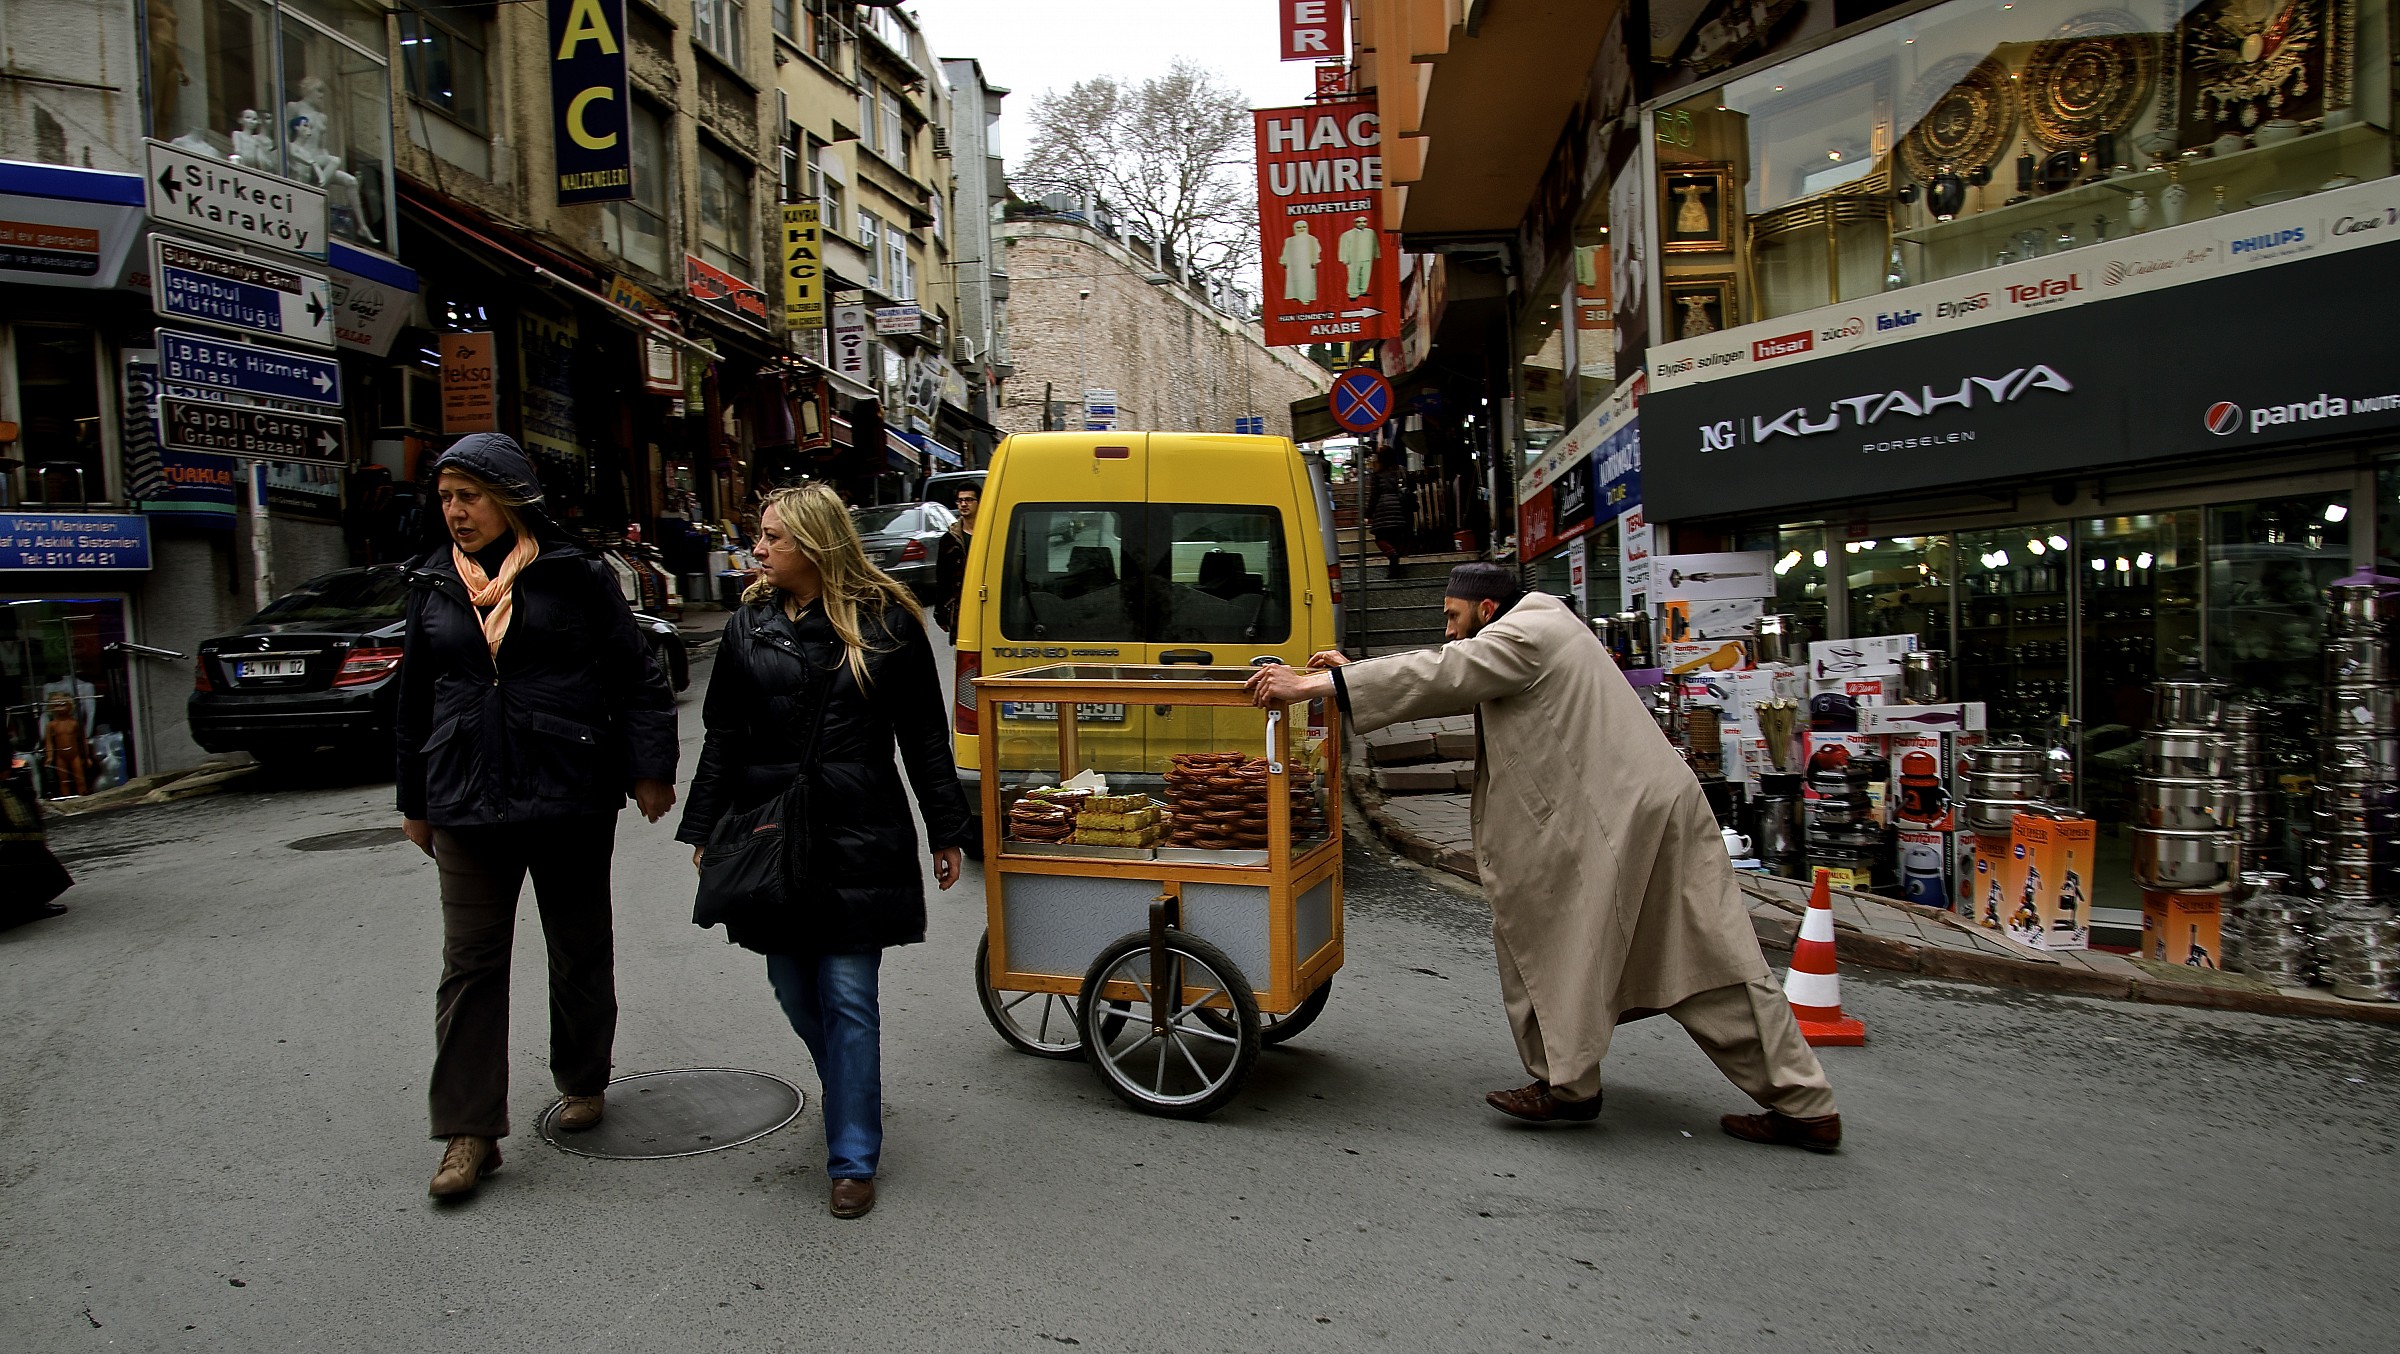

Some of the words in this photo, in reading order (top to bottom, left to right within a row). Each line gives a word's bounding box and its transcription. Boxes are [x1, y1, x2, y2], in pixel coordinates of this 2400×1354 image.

[185, 164, 292, 213] Sirkeci
[1268, 156, 1382, 196] UMRE
[1286, 197, 1372, 216] KIYAFETLERİ
[187, 193, 308, 249] Karaköy
[2232, 228, 2304, 254] PHILIPS
[163, 248, 259, 281] Süleymaniye
[788, 228, 817, 297] HACI
[165, 268, 240, 302] İstanbul
[2005, 274, 2083, 303] Tefal
[168, 291, 279, 328] Müftülüğü
[1310, 322, 1360, 336] AKABE
[1697, 350, 1744, 368] solingen
[1758, 338, 1809, 357] hisar
[170, 361, 238, 385] Binası
[245, 356, 310, 380] Hizmet
[444, 364, 491, 383] teksa
[172, 404, 245, 431] Kapalı
[253, 415, 309, 440] Çarşı
[2249, 393, 2348, 433] panda
[178, 425, 239, 448] (Grand
[244, 435, 307, 458] Bazaar)
[1700, 420, 1736, 452] NG
[1863, 430, 1976, 454] PORSELEN
[11, 520, 48, 531] Vitrin
[15, 539, 31, 548] ve
[78, 536, 140, 548] Sistemleri
[46, 553, 72, 565] 511
[76, 553, 96, 564] 44
[98, 553, 116, 565] 21
[992, 647, 1069, 658] TOURNEO
